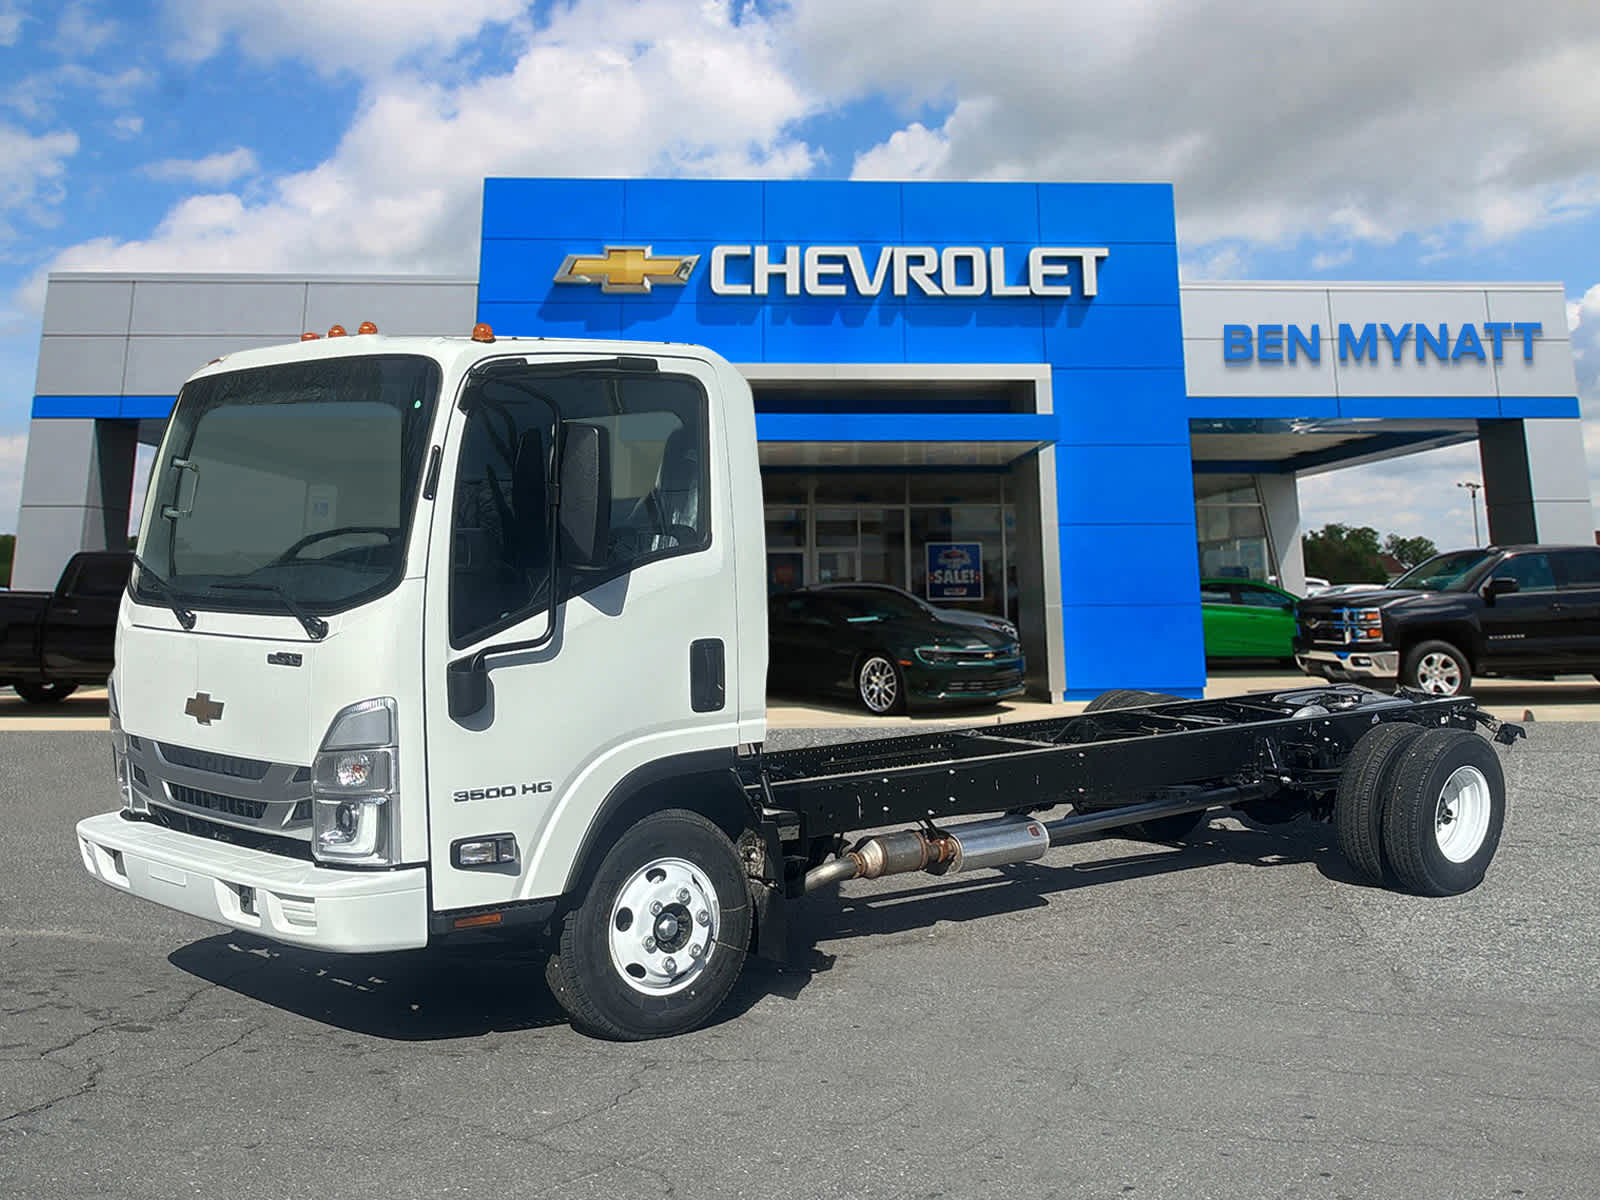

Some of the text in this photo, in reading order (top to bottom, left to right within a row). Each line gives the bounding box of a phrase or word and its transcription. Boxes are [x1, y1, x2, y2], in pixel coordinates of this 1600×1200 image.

[710, 244, 1110, 297] CHEVROLET
[1223, 322, 1543, 364] BEN MYNATT
[934, 569, 975, 584] SALE!
[453, 781, 553, 803] 3500 HG
